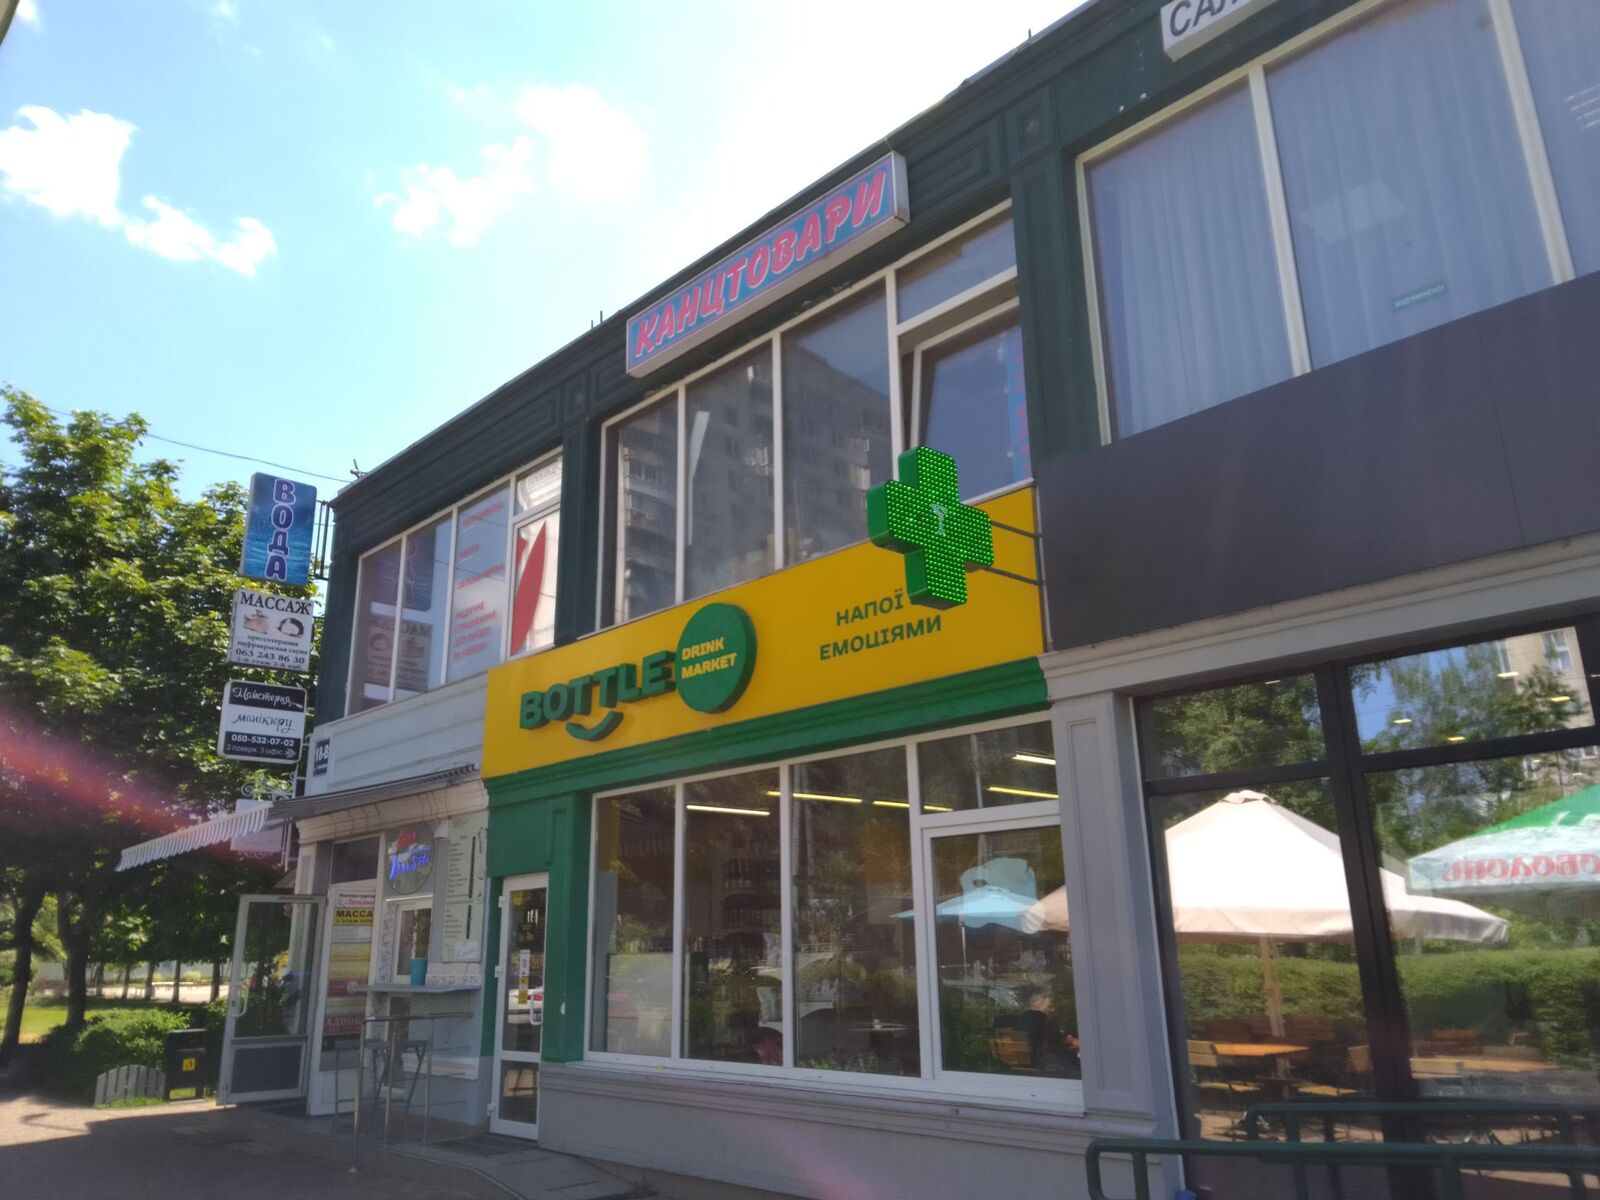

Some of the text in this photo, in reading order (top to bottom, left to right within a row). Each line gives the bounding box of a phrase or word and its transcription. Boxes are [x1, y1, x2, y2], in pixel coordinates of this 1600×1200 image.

[634, 170, 886, 357] КАНЦТОВАРИ
[264, 478, 297, 581] ВОДА
[240, 591, 312, 616] МАССАЖ
[835, 588, 904, 627] НАПОЇ
[681, 637, 726, 661] DRINK
[818, 614, 942, 661] ЕМОЦІЯМИ
[681, 652, 738, 680] MARKET
[519, 649, 677, 730] BOTTLE
[231, 734, 295, 748] 050-532-07-02
